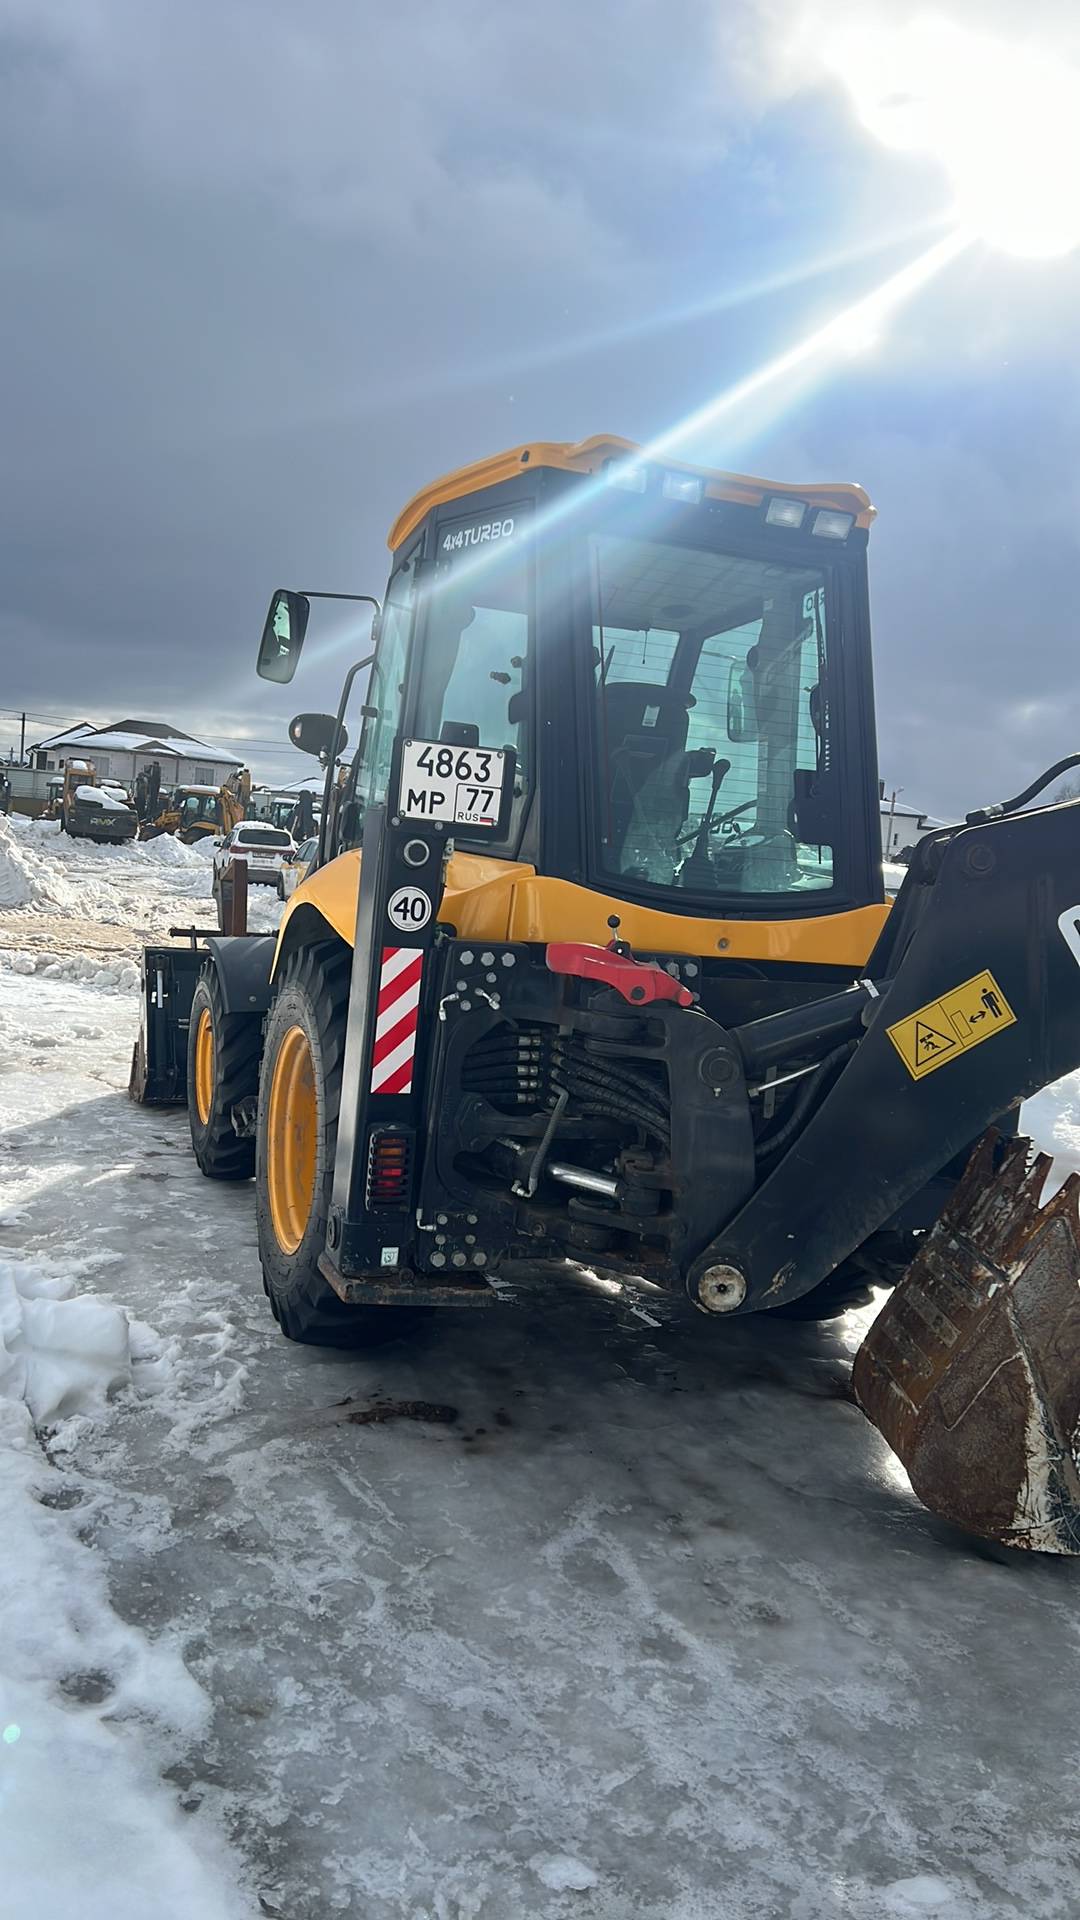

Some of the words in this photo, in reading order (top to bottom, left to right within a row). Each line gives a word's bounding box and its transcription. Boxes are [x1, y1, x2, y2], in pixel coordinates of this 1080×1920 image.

[416, 746, 492, 783] 4863
[406, 788, 446, 815] MP
[466, 788, 494, 813] 77
[457, 811, 479, 822] RUS
[393, 896, 426, 922] 40
